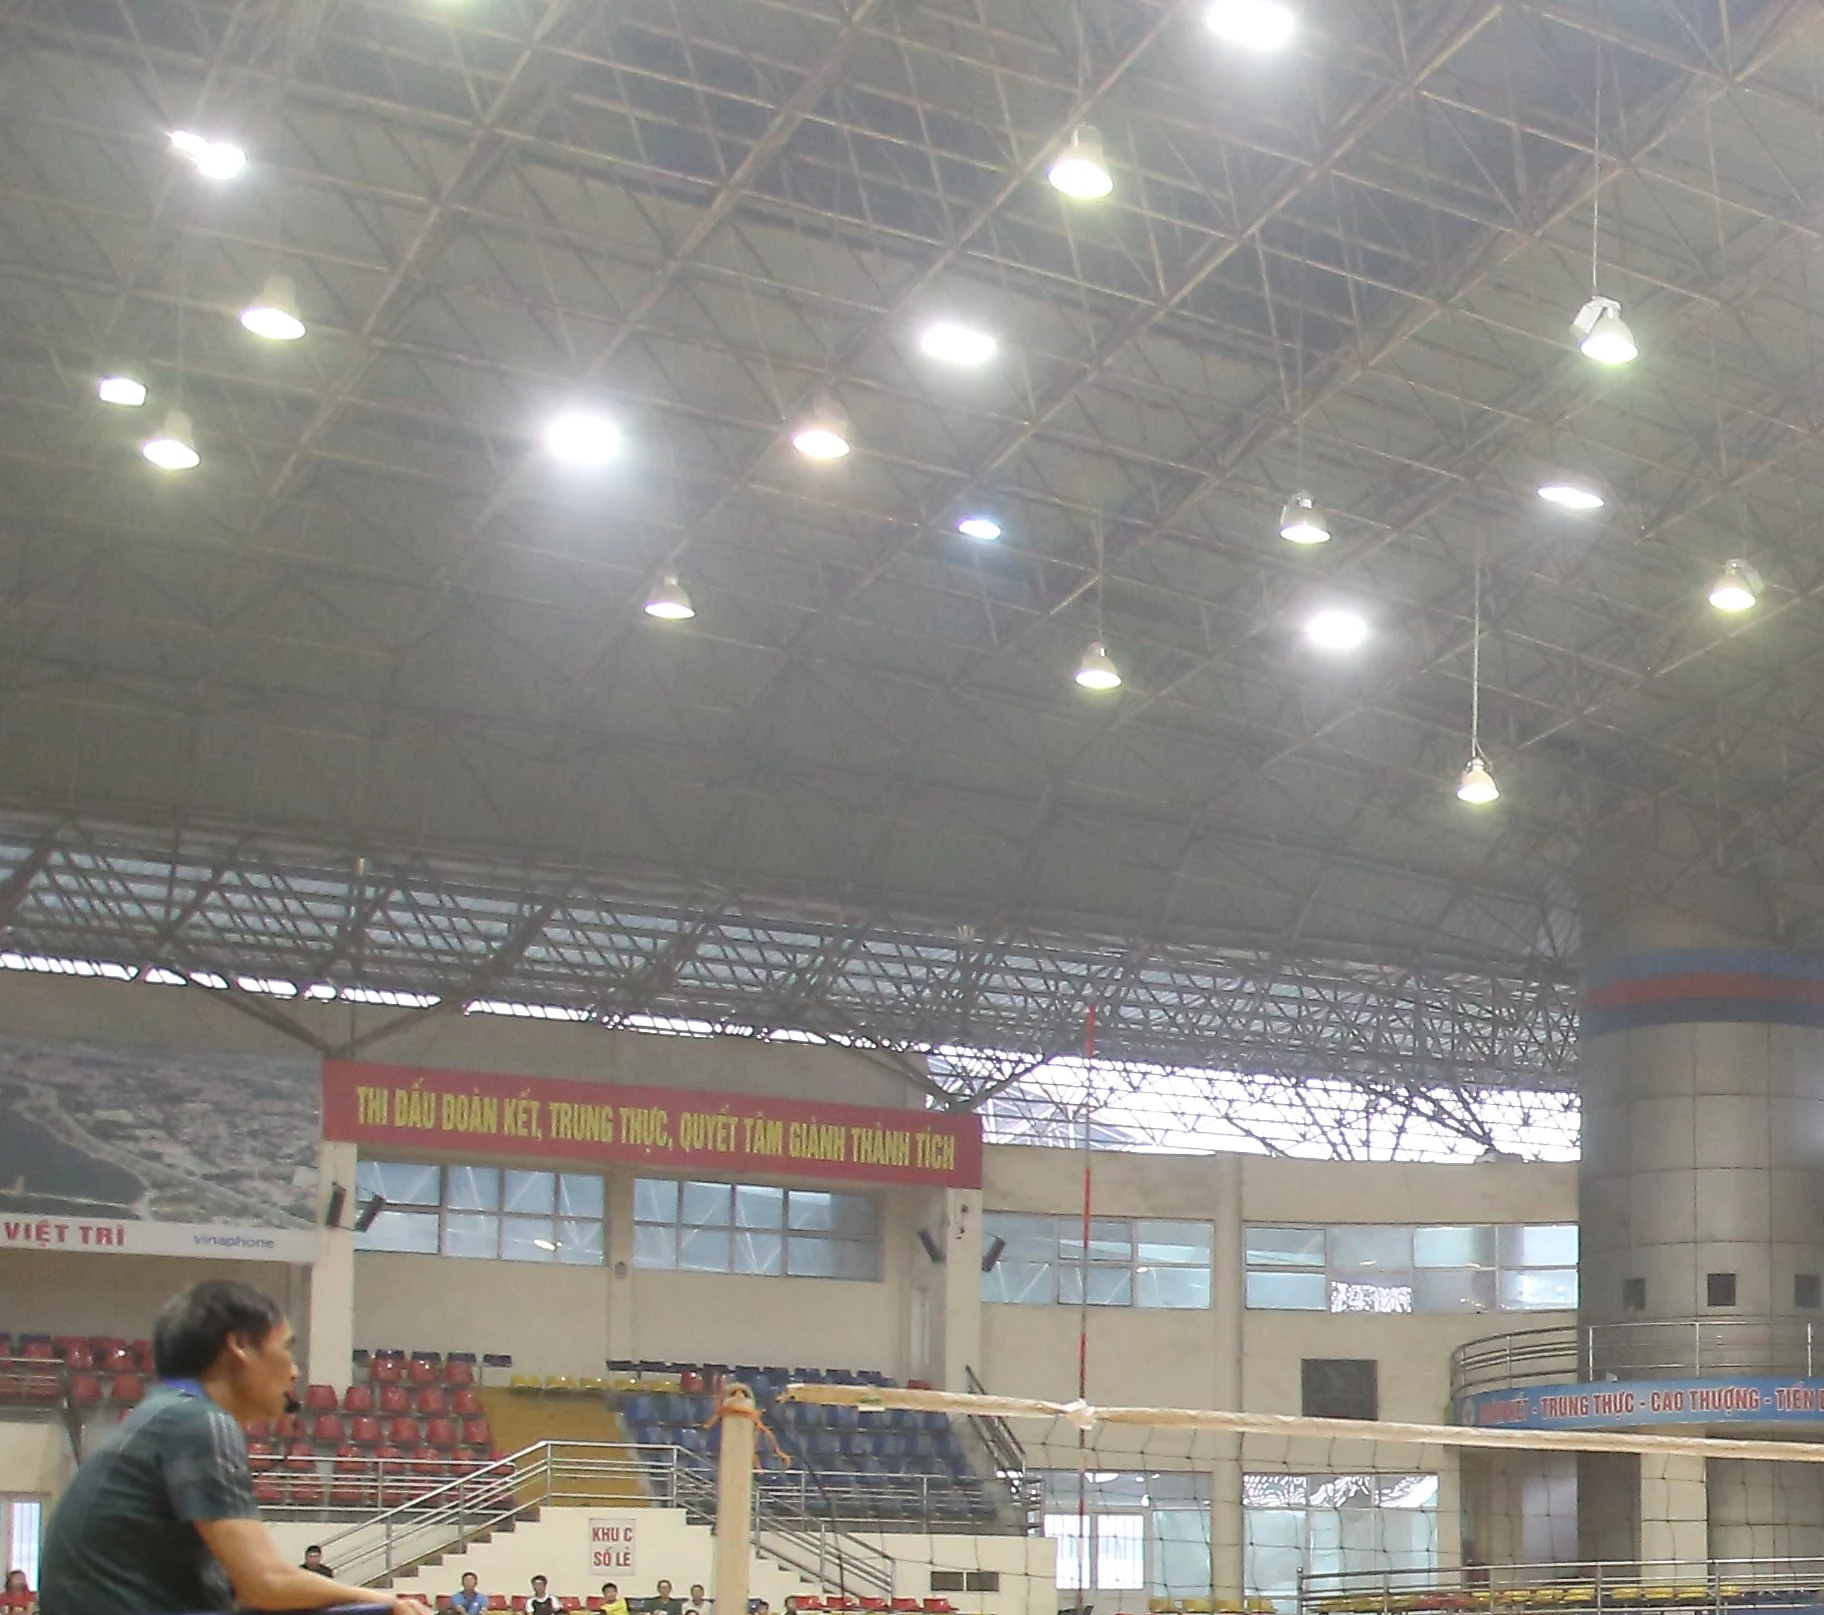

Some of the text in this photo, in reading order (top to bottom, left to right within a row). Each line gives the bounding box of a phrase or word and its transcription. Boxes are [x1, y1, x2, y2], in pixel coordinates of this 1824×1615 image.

[356, 1077, 955, 1170] THI ĐẤU ĐOÀN KẾT, TRUNG THỰC, QUYẾT TÂM GIÀNH THÀNH TÍCH
[4, 1218, 125, 1248] VIỆT TRÌ
[194, 1233, 275, 1250] vinaphone
[1541, 1395, 1589, 1420] TRUNG
[1593, 1390, 1634, 1420] THỰC
[1651, 1390, 1685, 1413] CAO
[1689, 1385, 1760, 1417] THƯỢNG
[1776, 1381, 1816, 1411] TIẾN
[592, 1527, 633, 1542] KHU C
[593, 1546, 612, 1567] SỐ
